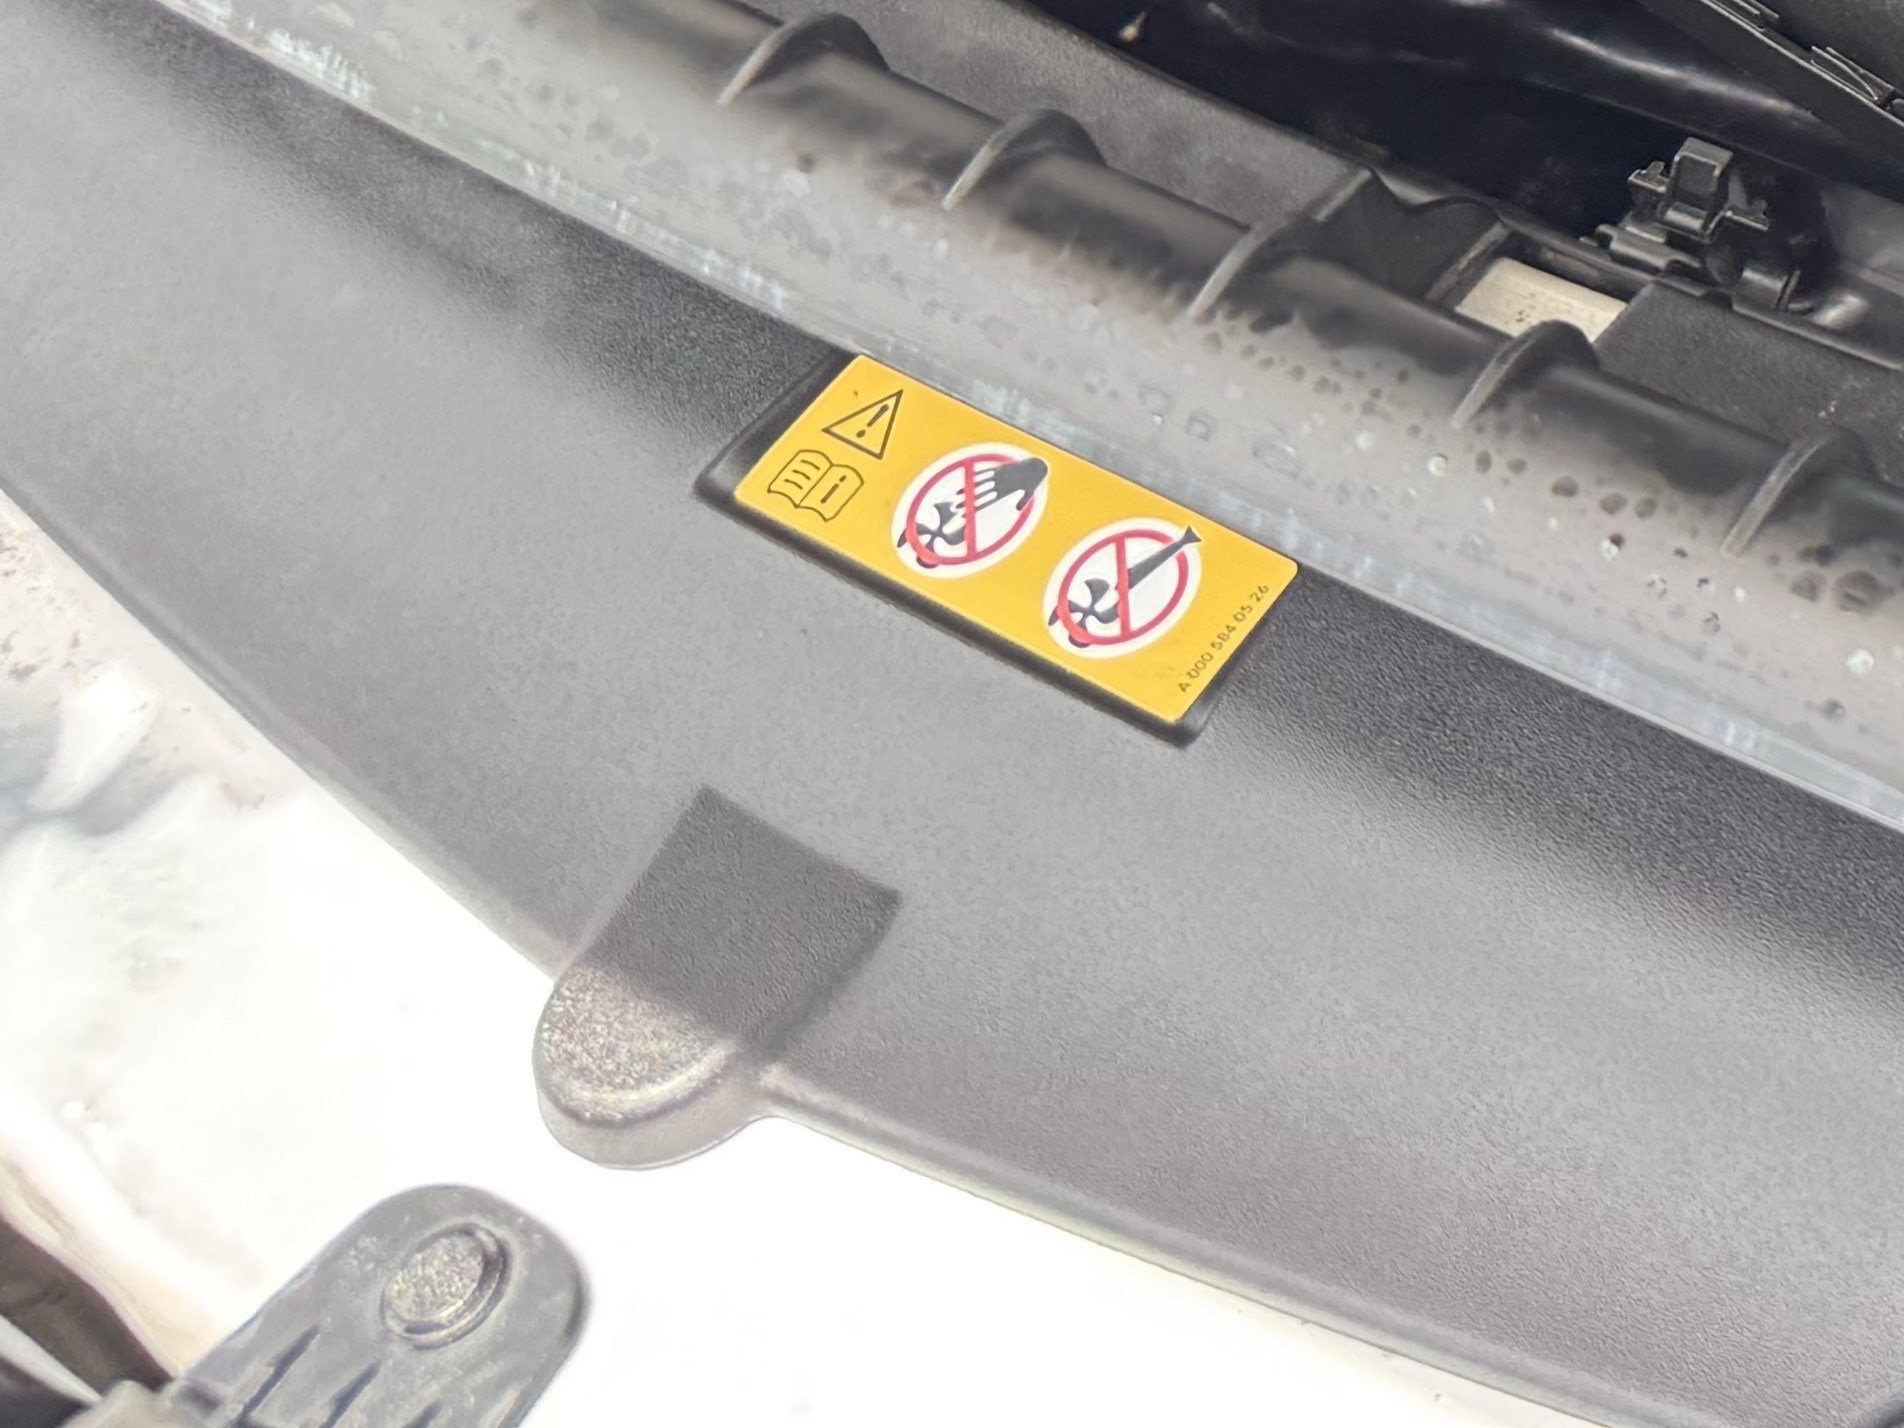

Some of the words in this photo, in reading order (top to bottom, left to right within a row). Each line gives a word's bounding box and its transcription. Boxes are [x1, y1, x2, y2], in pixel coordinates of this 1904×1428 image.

[1177, 682, 1192, 693] A
[1185, 651, 1215, 680] 000
[1209, 624, 1237, 651] 584
[1232, 604, 1254, 623] 05
[1249, 585, 1270, 603] 26
